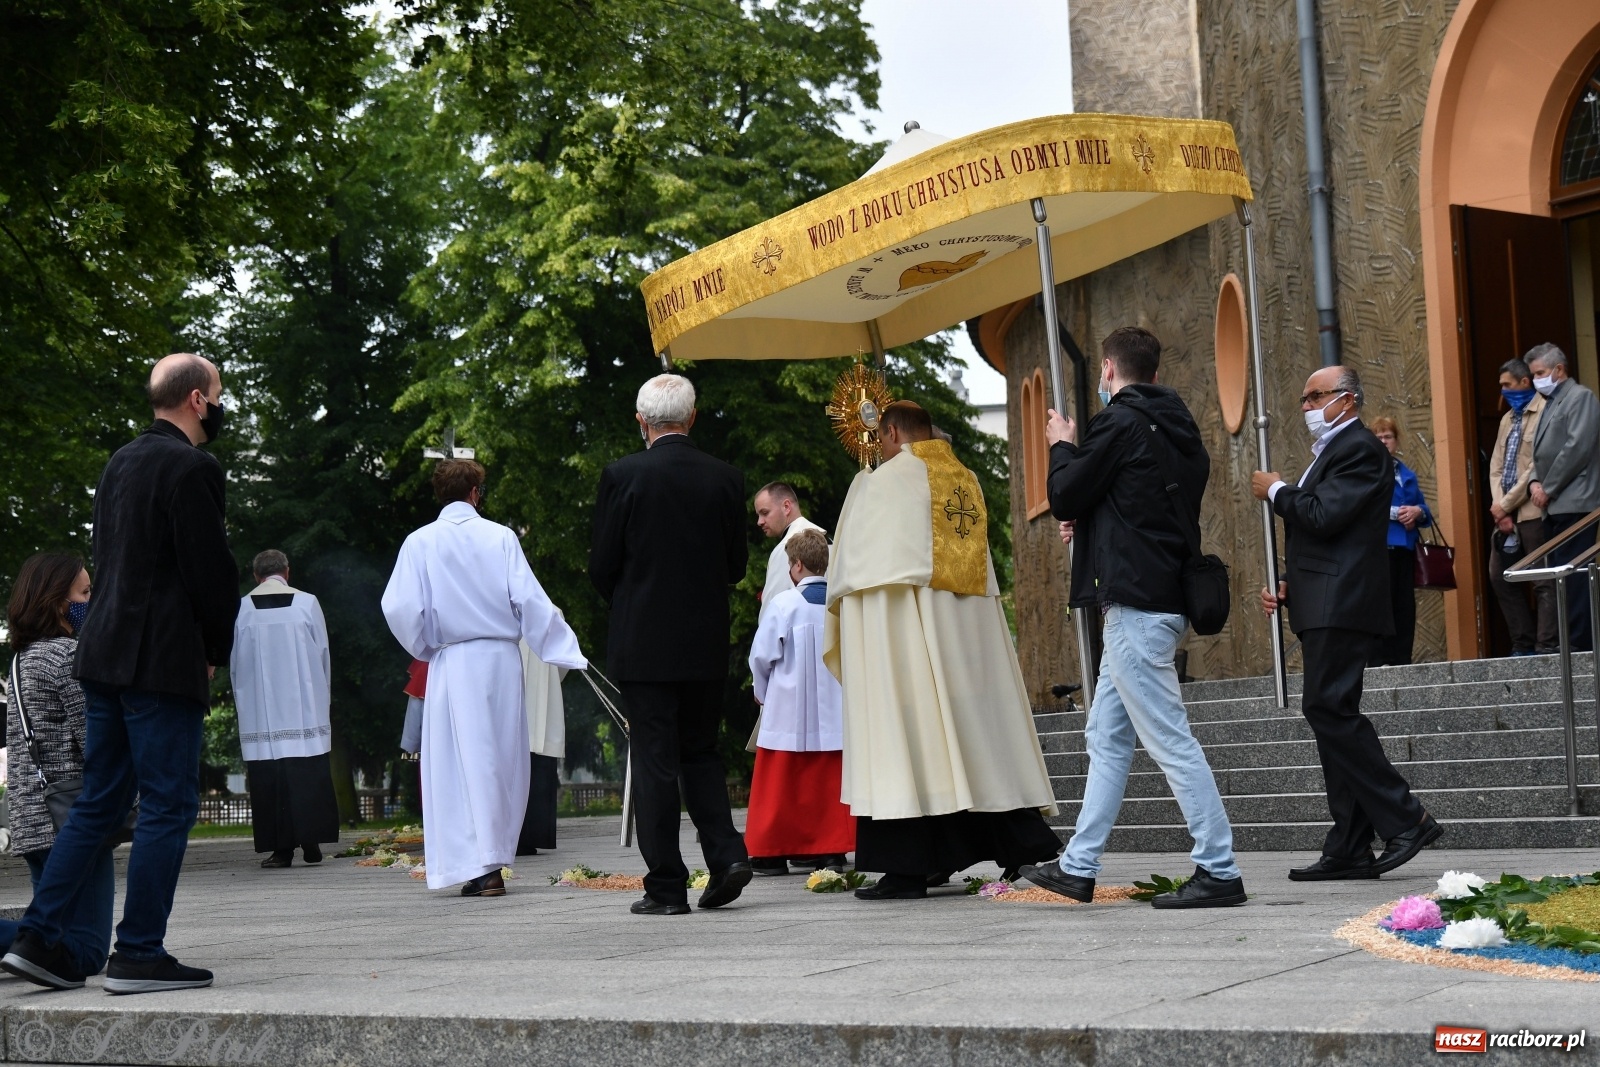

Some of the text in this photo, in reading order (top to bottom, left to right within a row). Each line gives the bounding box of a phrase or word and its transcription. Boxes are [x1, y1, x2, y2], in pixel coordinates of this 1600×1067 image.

[807, 139, 1111, 250] WODO Z BOKU CHRYSTUSA OBMYJ MNIE
[692, 268, 726, 303] MNIE
